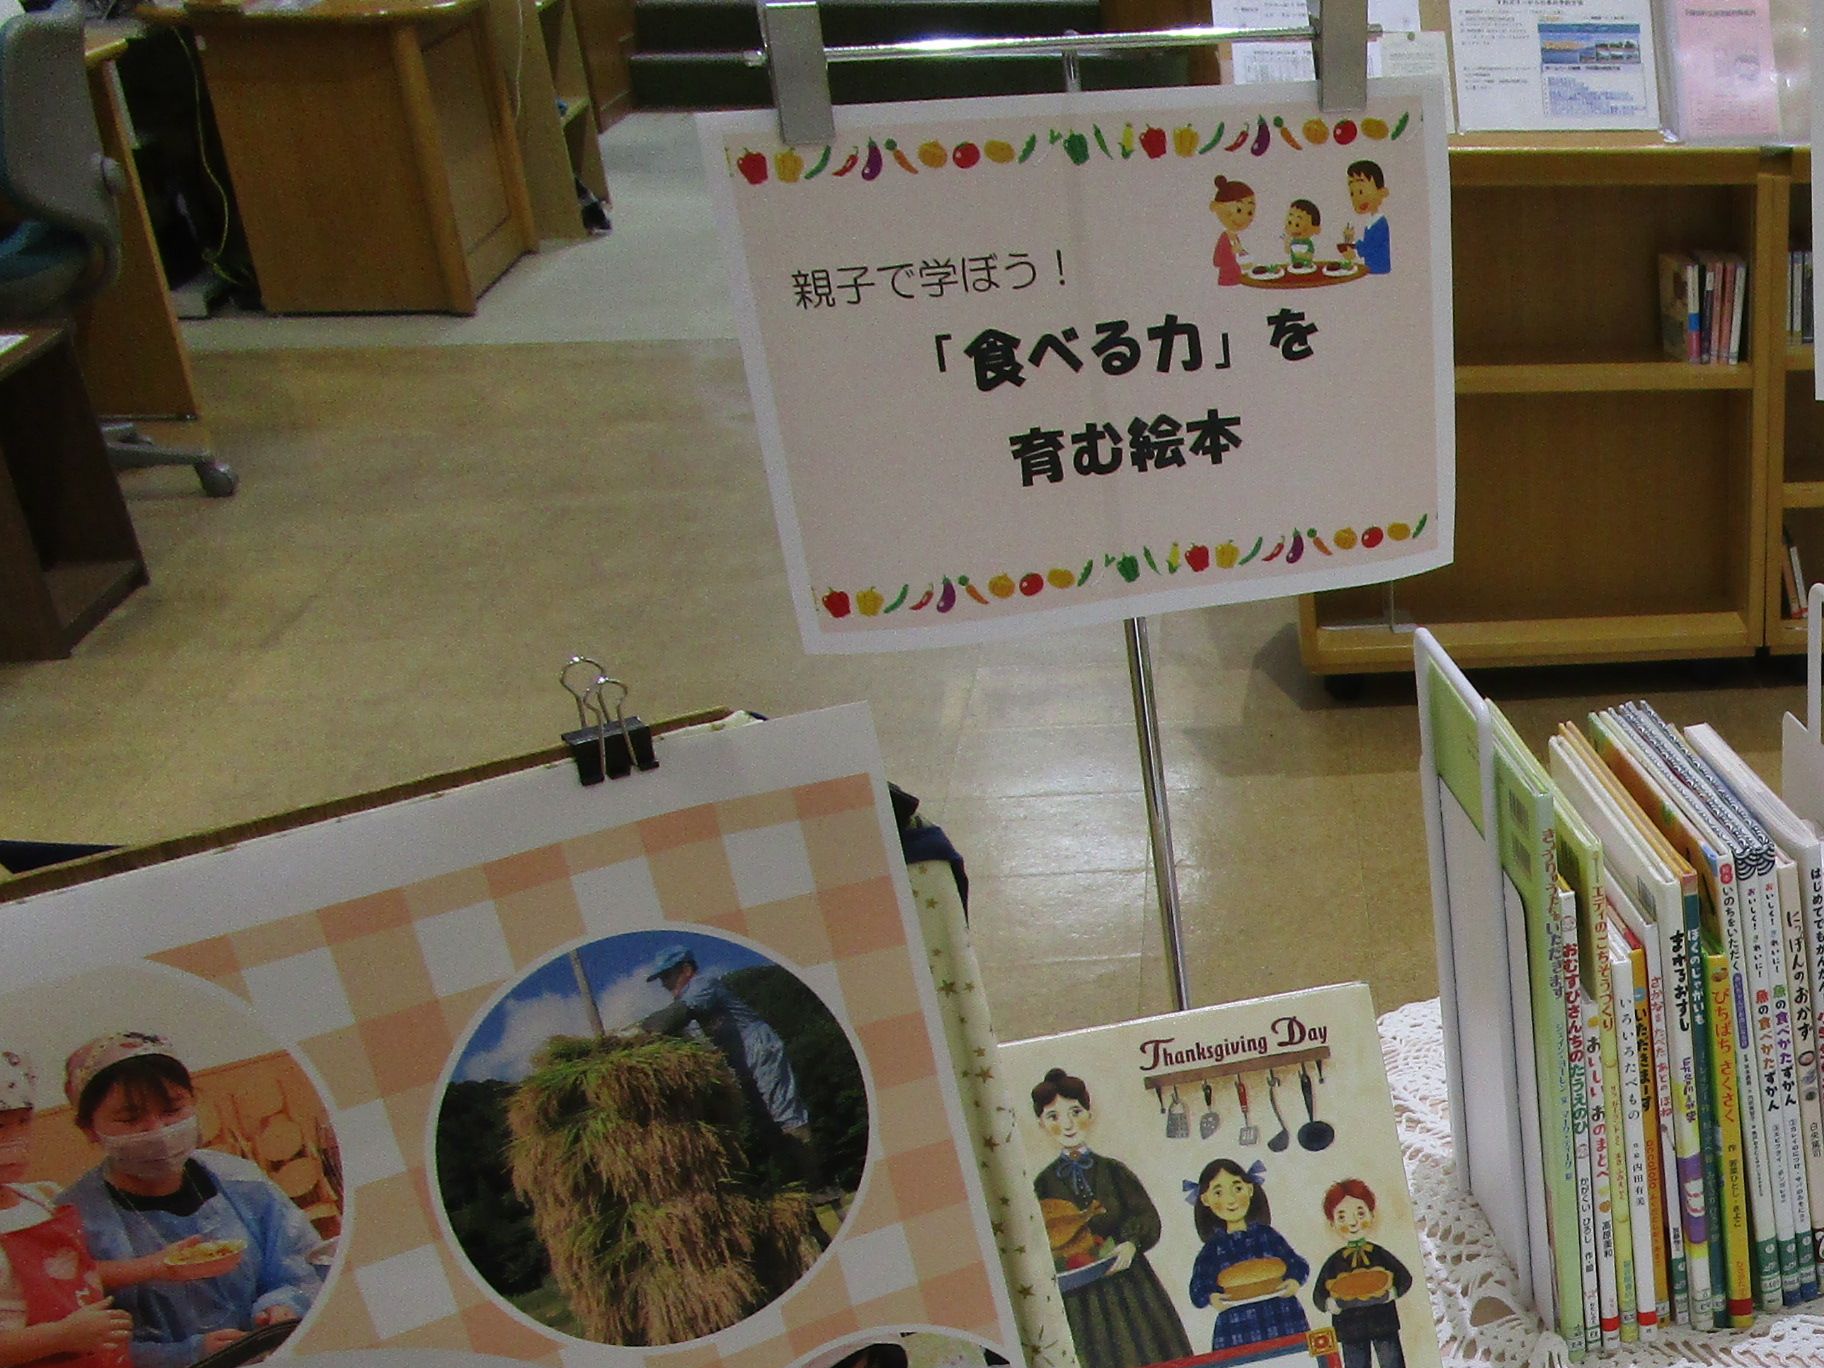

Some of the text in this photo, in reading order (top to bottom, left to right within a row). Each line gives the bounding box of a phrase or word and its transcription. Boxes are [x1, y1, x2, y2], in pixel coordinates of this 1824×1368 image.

[792, 250, 1068, 309] 親子で学ぼう！
[935, 308, 1319, 391] 「食べる力」を
[1009, 409, 1243, 487] 育む絵本
[1722, 886, 1741, 971] いのちをいただく
[1786, 911, 1815, 1042] にっぽんのおかず
[1139, 1015, 1329, 1072] Thanksgiving Day
[1620, 1000, 1641, 1120] いろいろたべもの
[1755, 989, 1780, 1112] 魚の食べかたずかん
[1772, 984, 1797, 1106] 魚の食べかたずかん
